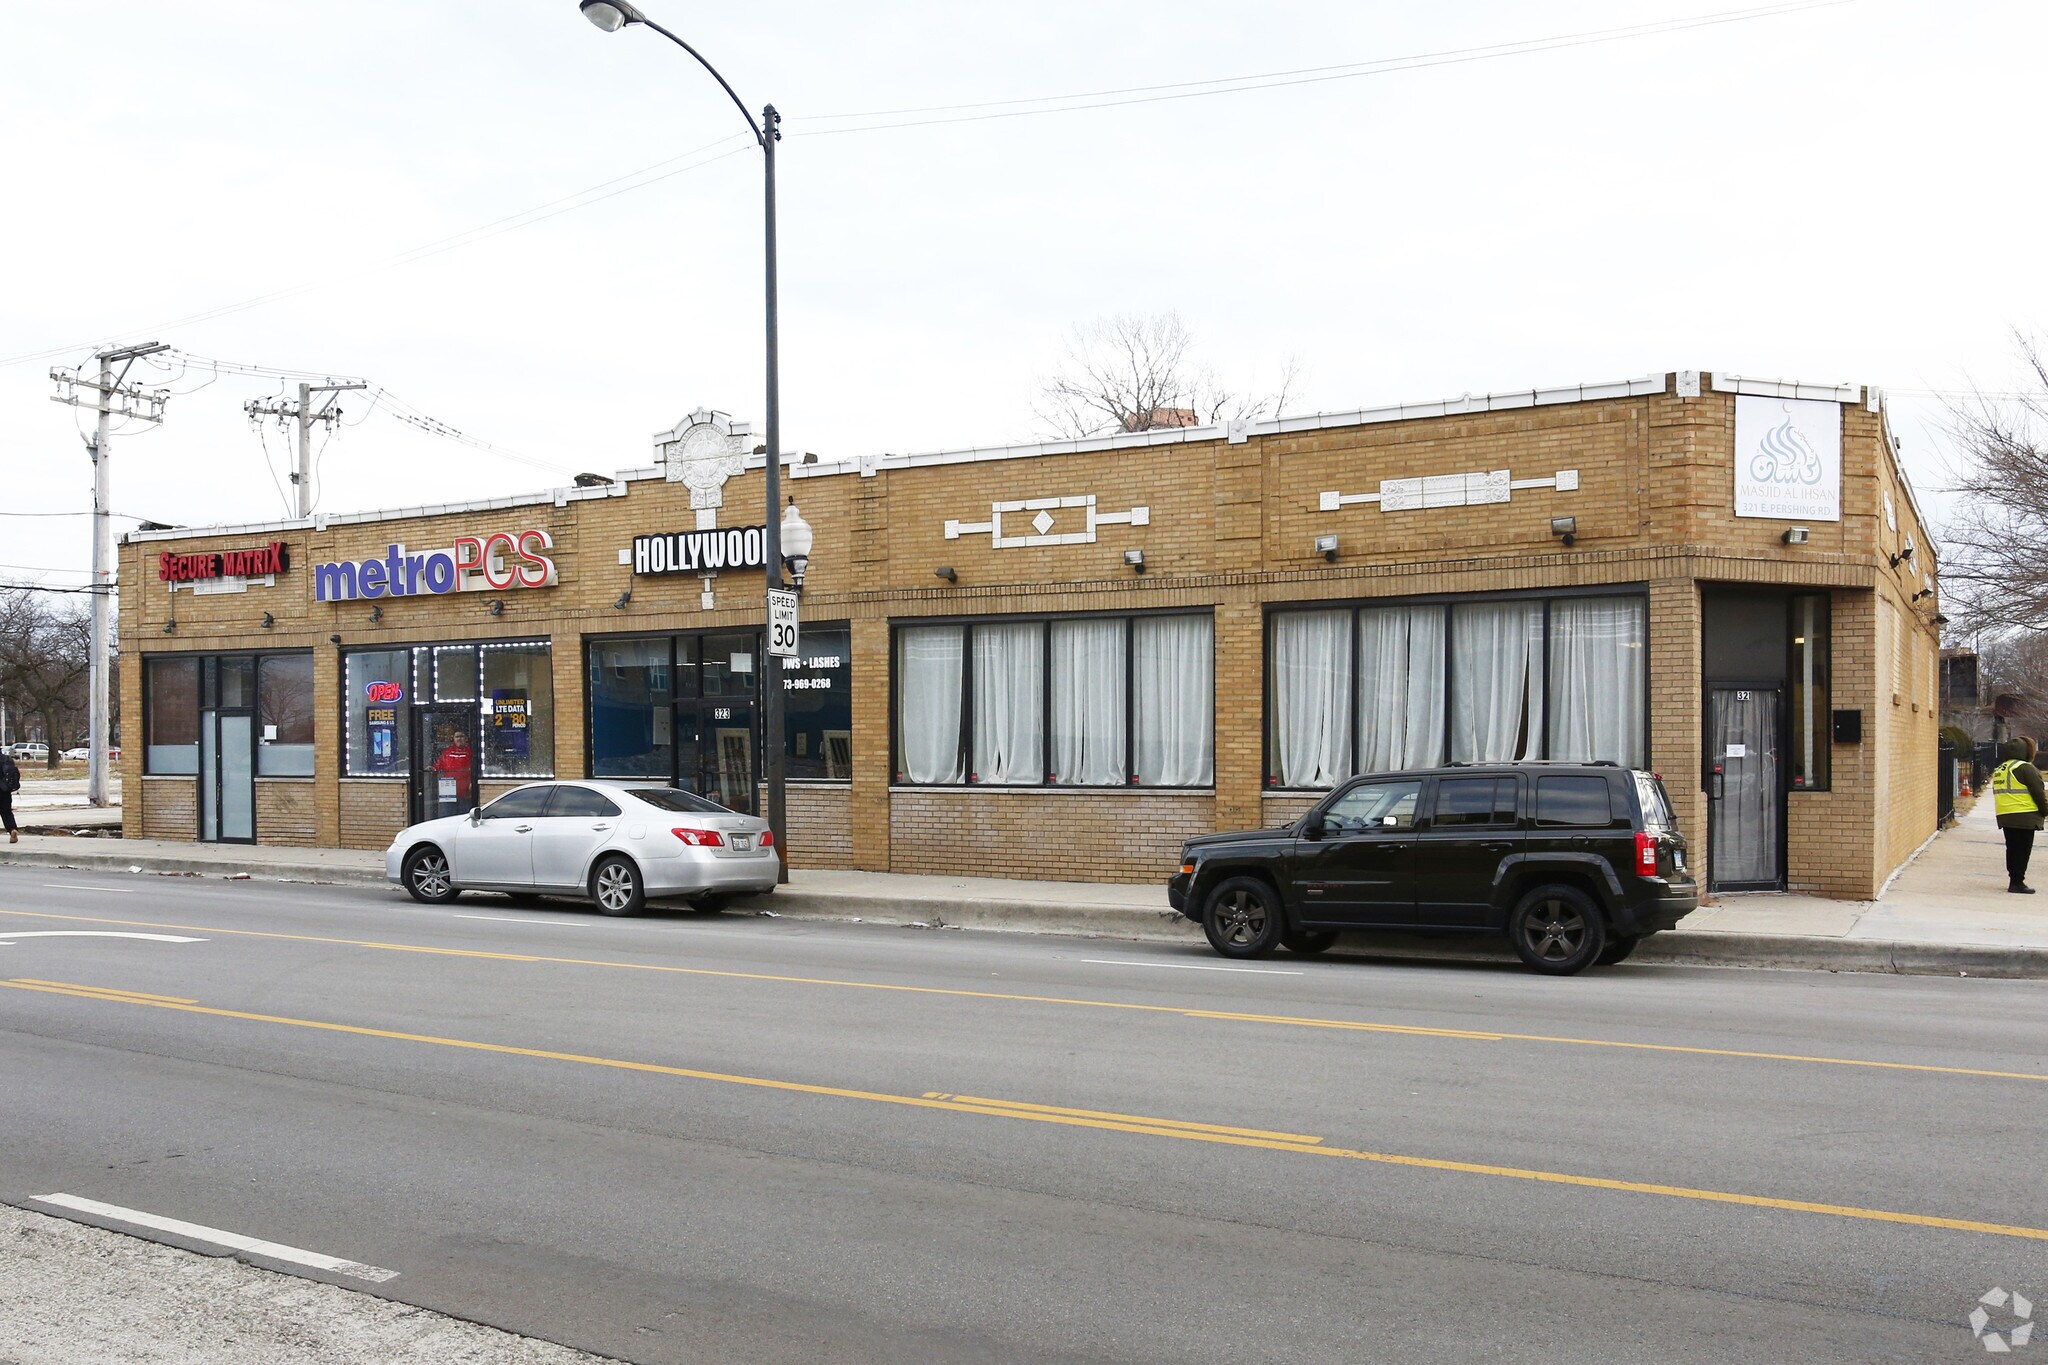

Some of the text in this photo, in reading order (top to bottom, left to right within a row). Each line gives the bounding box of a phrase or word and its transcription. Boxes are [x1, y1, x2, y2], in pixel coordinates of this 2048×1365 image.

[1740, 484, 1836, 501] MASJID AL IHSAN
[1743, 502, 1833, 516] 321 E. PERSHING RD.
[159, 541, 282, 580] SECURE MATRIX
[315, 530, 553, 601] metroPCS
[771, 595, 796, 609] SPEED
[774, 610, 794, 621] LIMIT
[773, 623, 795, 648] 30
[809, 656, 840, 669] LASHES
[369, 683, 399, 701] OPEN
[368, 710, 395, 720] FREE
[495, 705, 525, 713] LTE DATA
[714, 708, 730, 720] 323
[495, 713, 503, 726] 2
